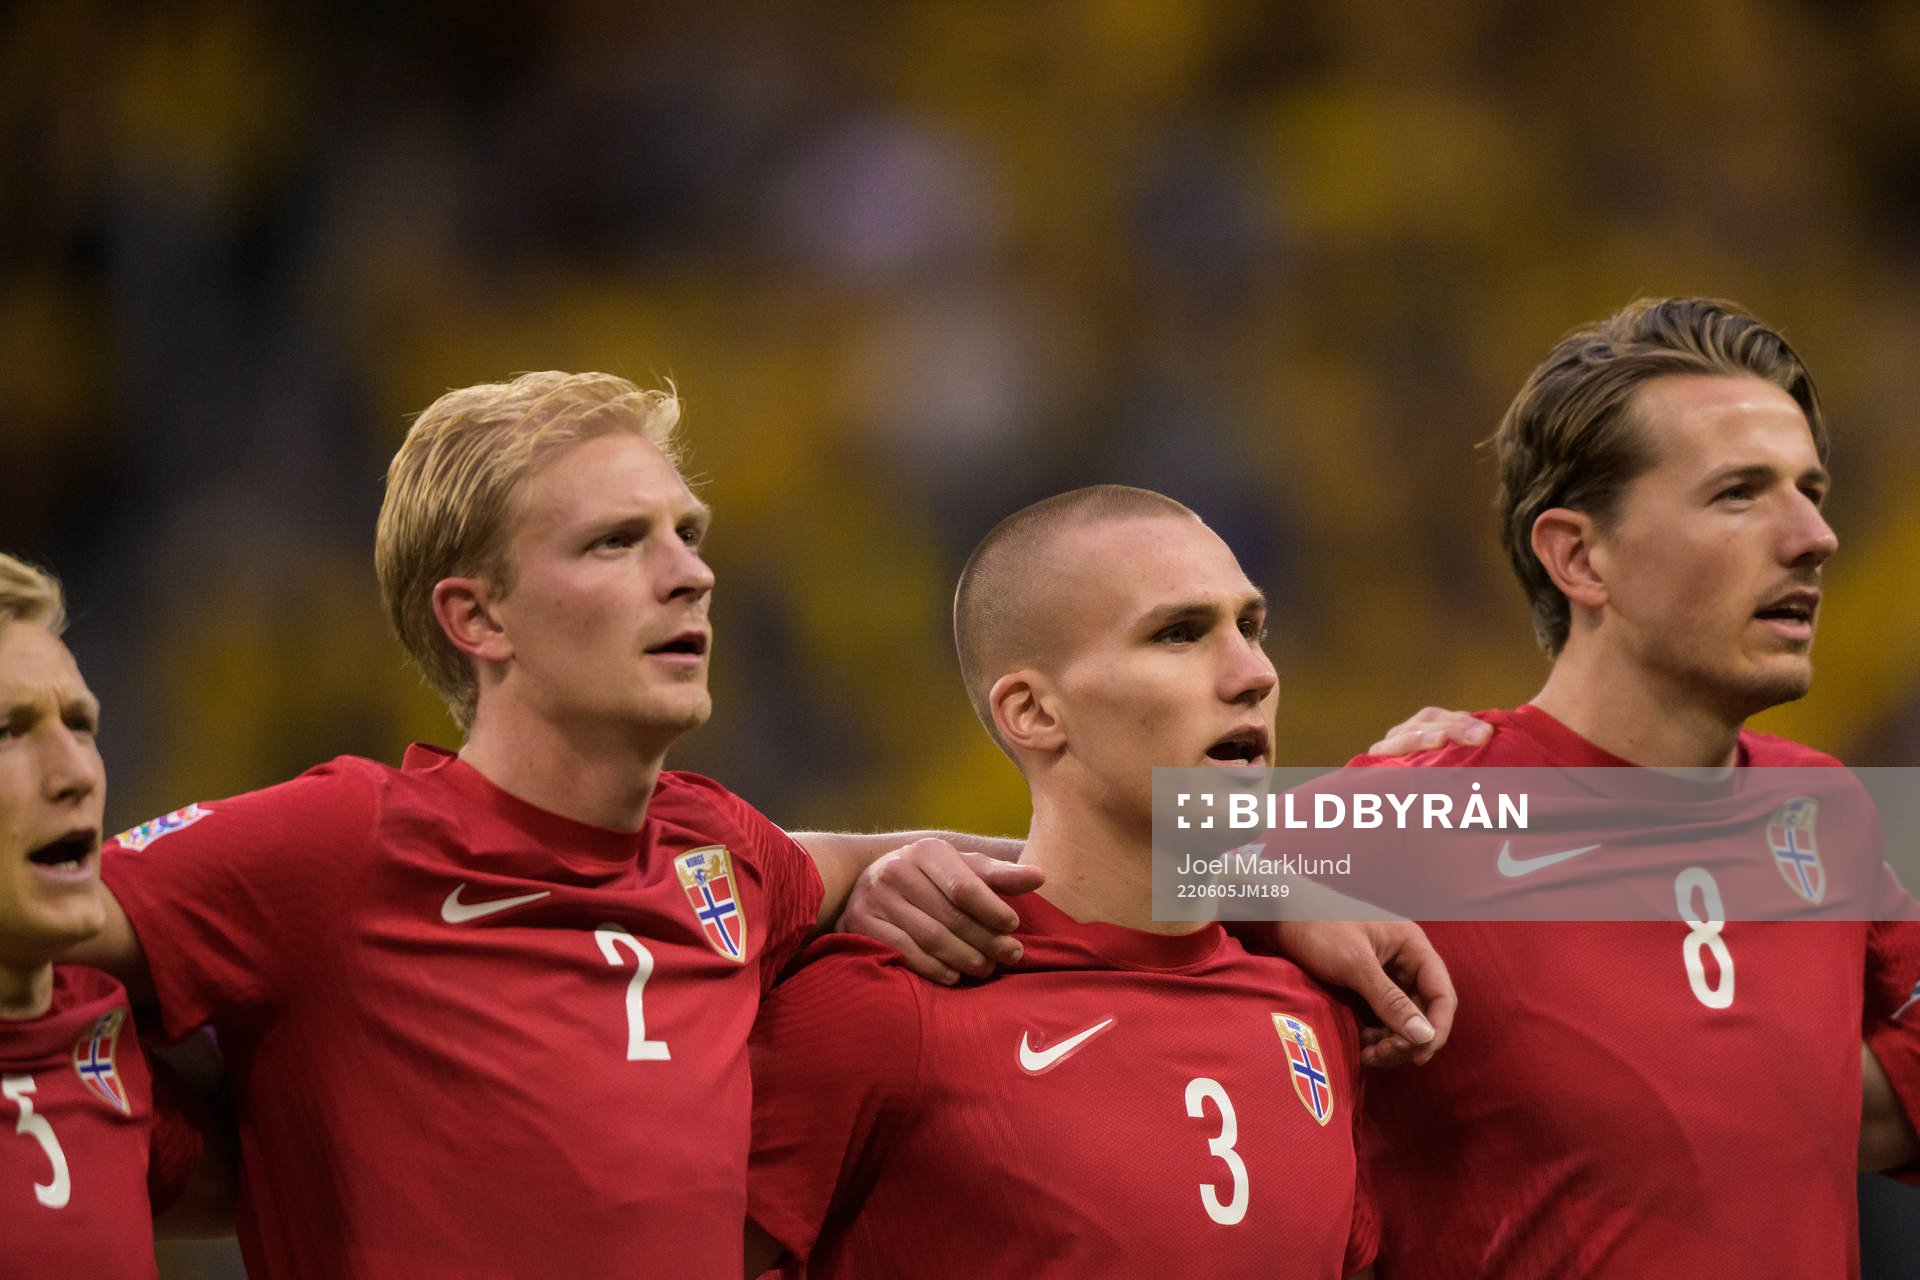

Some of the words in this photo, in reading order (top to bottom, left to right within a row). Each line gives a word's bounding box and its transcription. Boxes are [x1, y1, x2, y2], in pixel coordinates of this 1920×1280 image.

[594, 922, 671, 1061] 2
[1674, 866, 1735, 1009] 8
[2, 1074, 71, 1209] 5
[1185, 1077, 1249, 1225] 3
